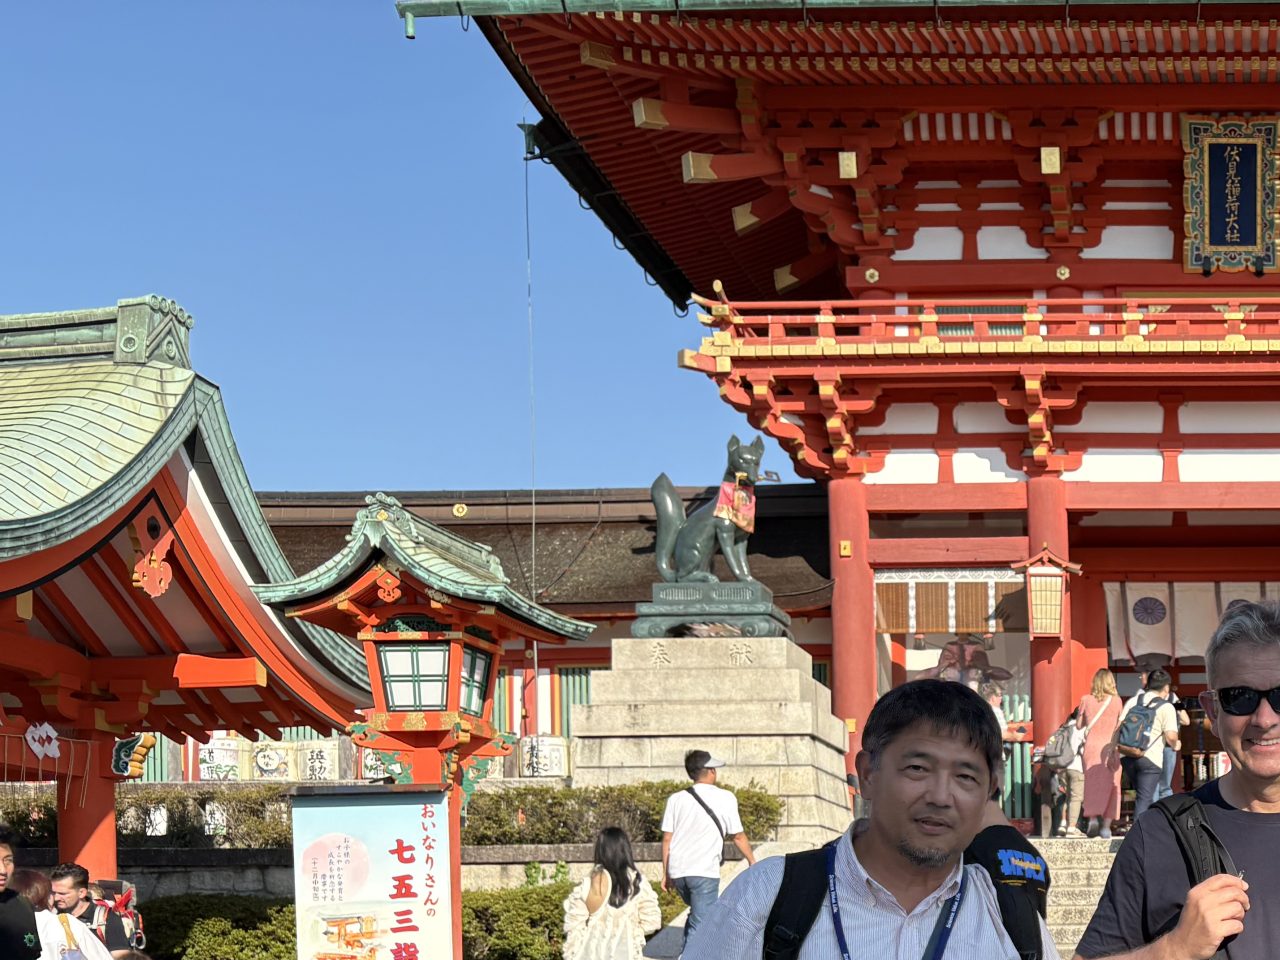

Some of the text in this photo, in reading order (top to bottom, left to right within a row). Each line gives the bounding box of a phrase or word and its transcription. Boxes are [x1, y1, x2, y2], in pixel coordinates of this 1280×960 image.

[1223, 146, 1242, 243] 伏見稲荷大社
[421, 804, 439, 917] おいなりさんの
